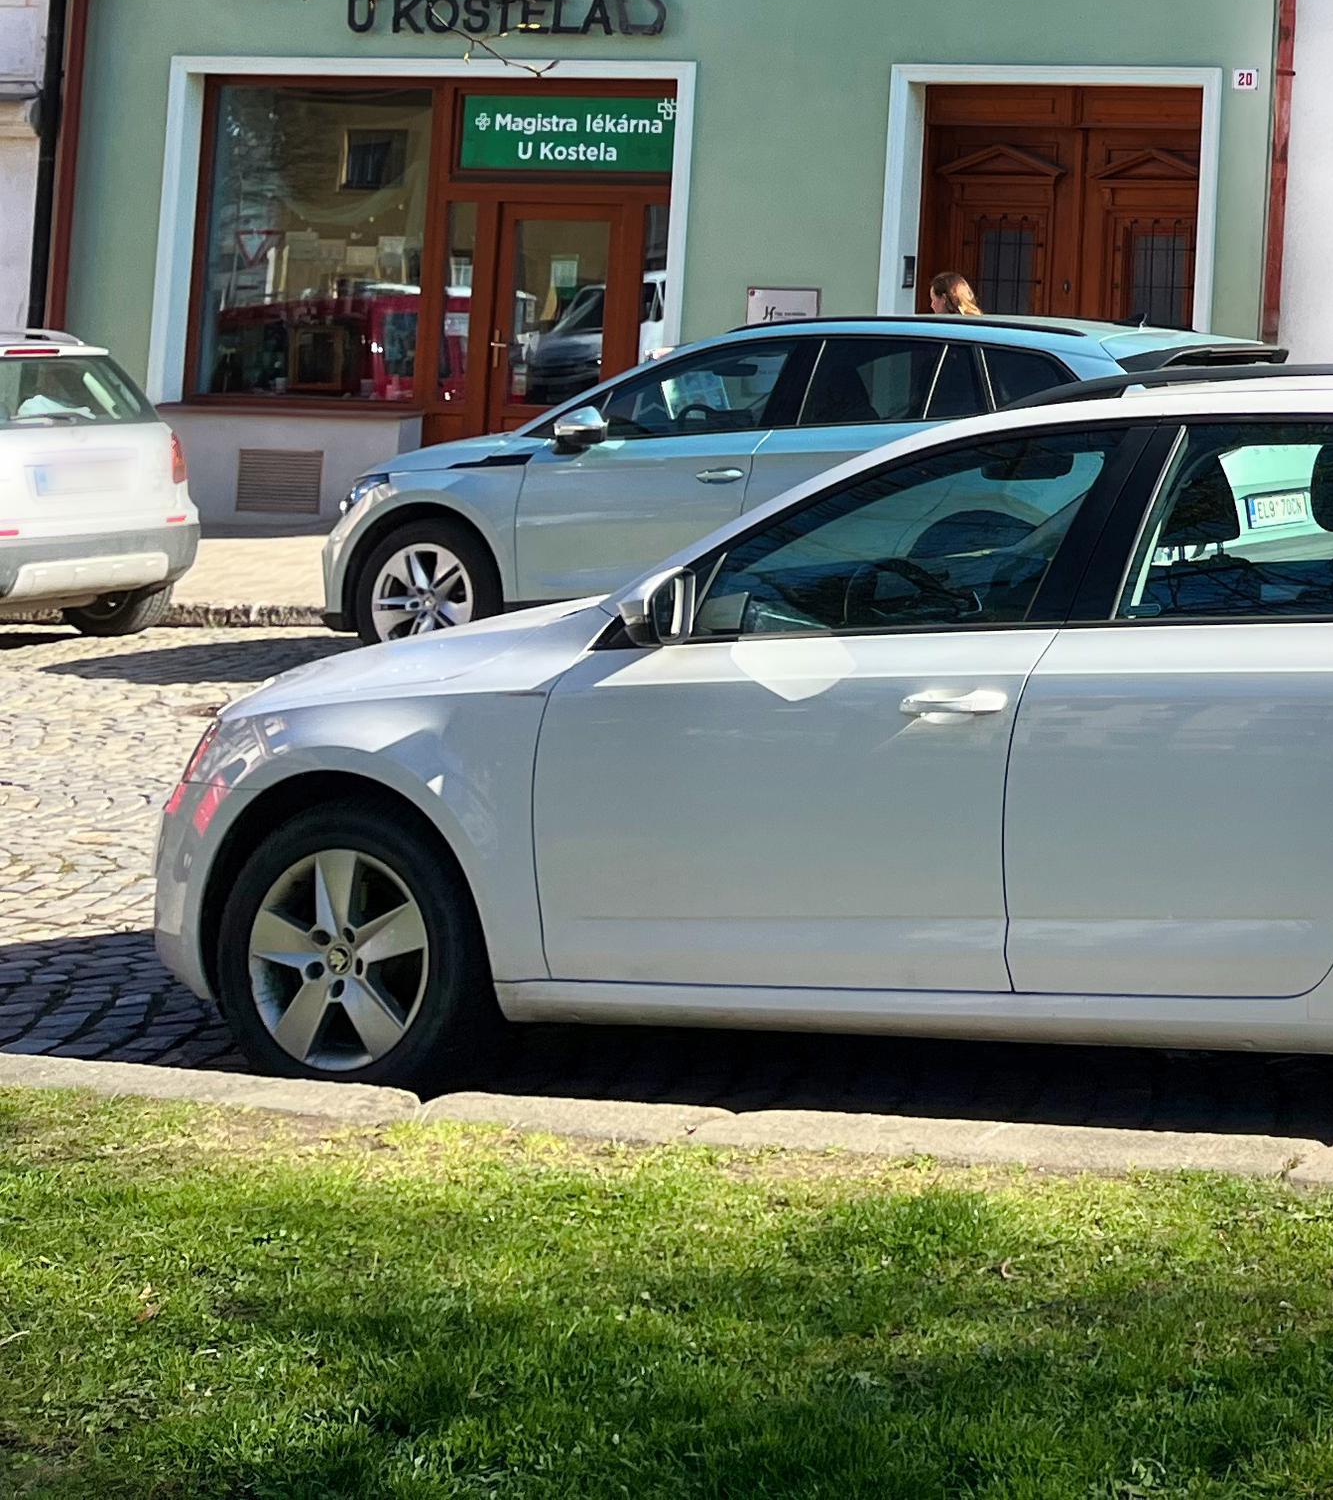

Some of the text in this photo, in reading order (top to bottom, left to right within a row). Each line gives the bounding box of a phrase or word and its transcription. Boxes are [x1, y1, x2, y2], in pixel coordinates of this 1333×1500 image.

[1238, 73, 1253, 86] 20
[495, 113, 663, 134] Magistra lékárna
[517, 142, 617, 161] U Kostela
